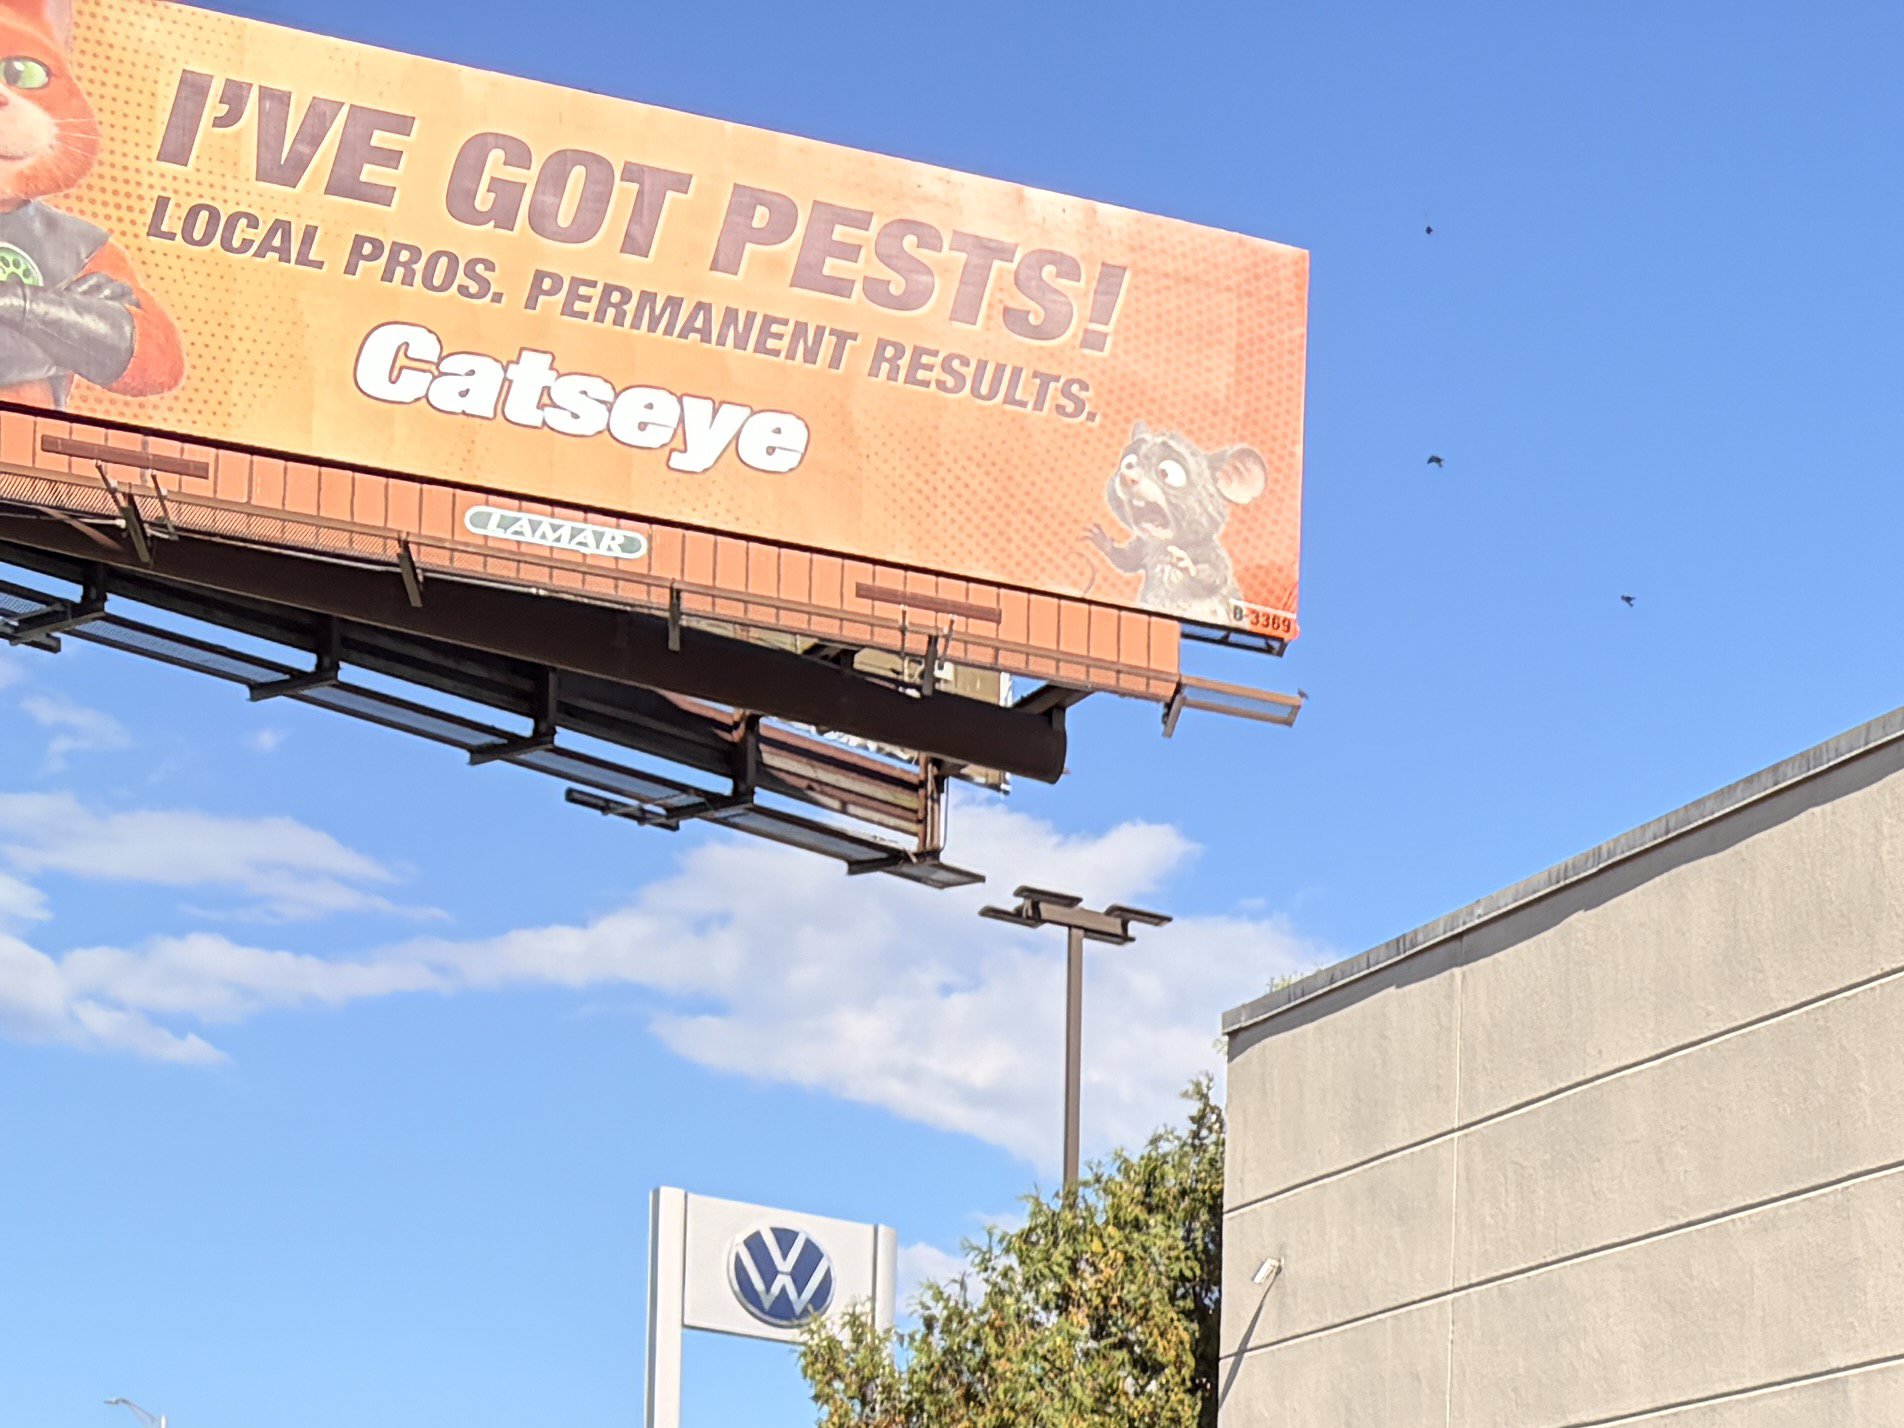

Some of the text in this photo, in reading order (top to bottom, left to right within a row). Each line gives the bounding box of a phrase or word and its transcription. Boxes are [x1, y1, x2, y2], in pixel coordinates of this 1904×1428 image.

[156, 69, 1127, 353] I'VE GOT PESTS!
[147, 195, 1098, 423] LOCAL PROS. PERMANENT RESULTS.
[354, 321, 809, 475] Catseye
[486, 512, 626, 553] LAMAR
